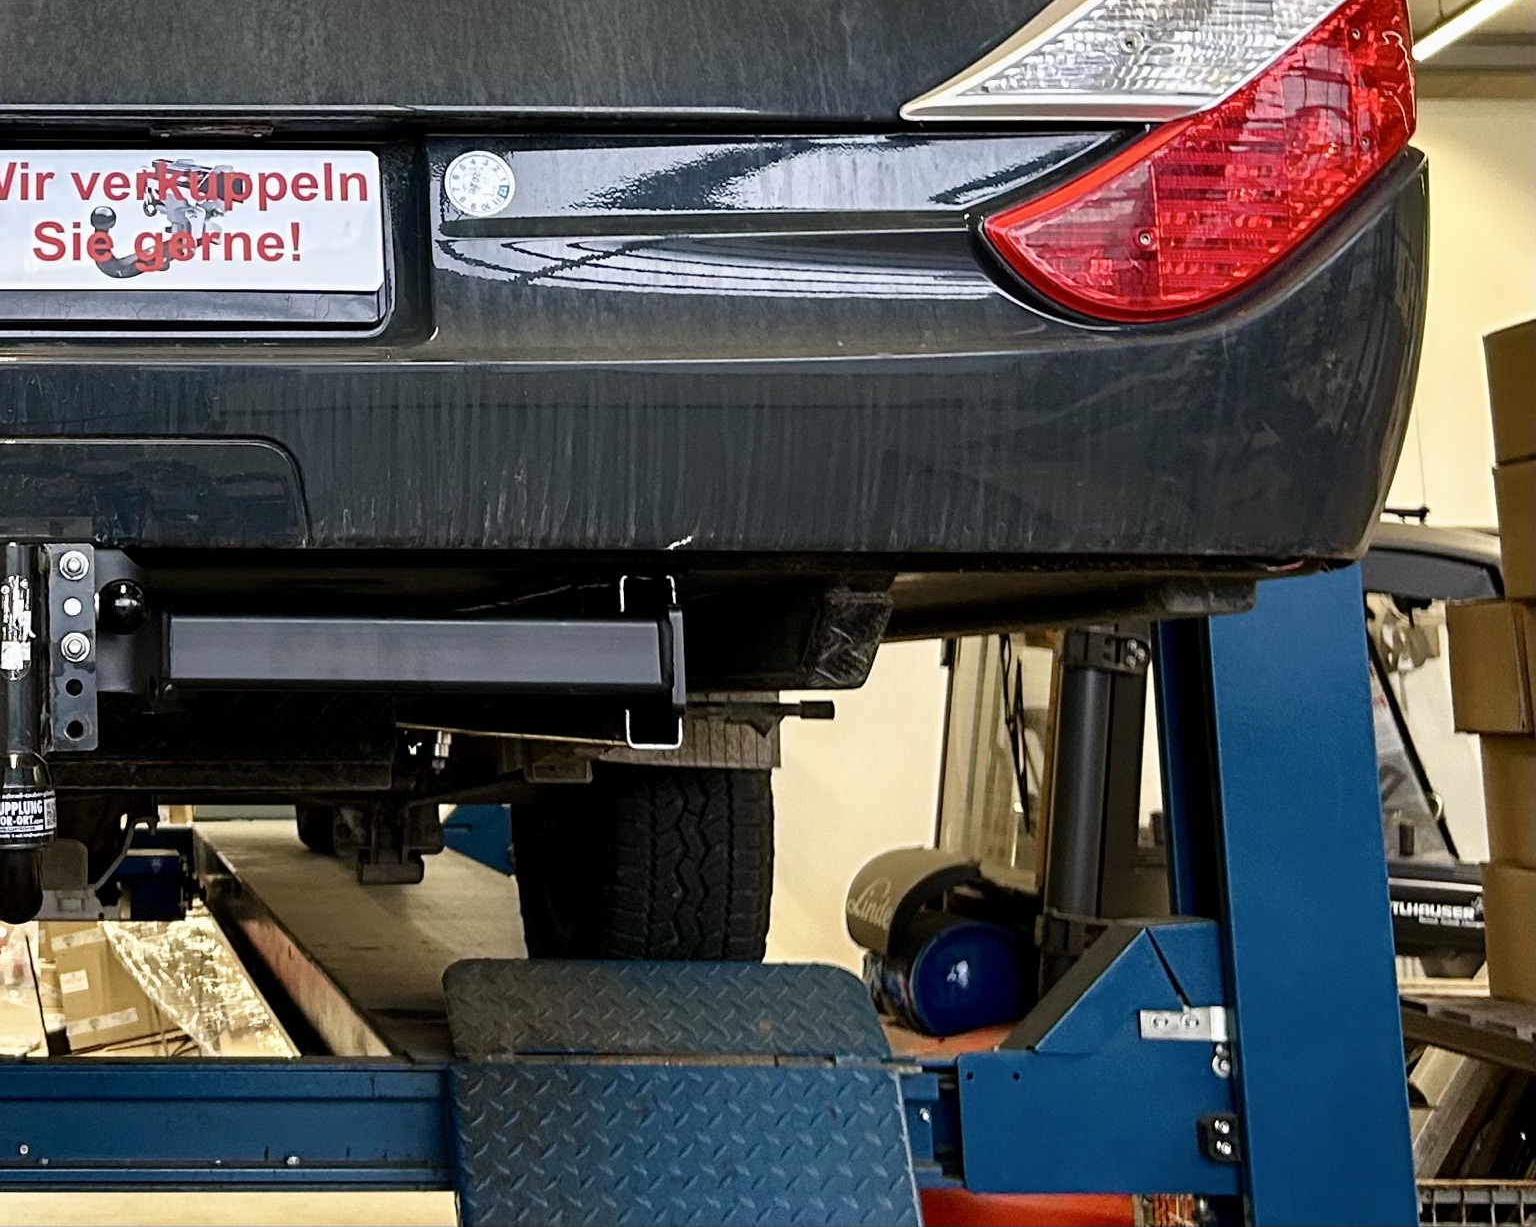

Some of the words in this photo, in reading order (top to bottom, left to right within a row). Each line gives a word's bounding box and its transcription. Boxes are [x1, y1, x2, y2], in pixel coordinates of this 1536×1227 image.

[70, 161, 368, 211] verkuppeln
[33, 221, 114, 262] Sie
[134, 222, 300, 272] gerne!
